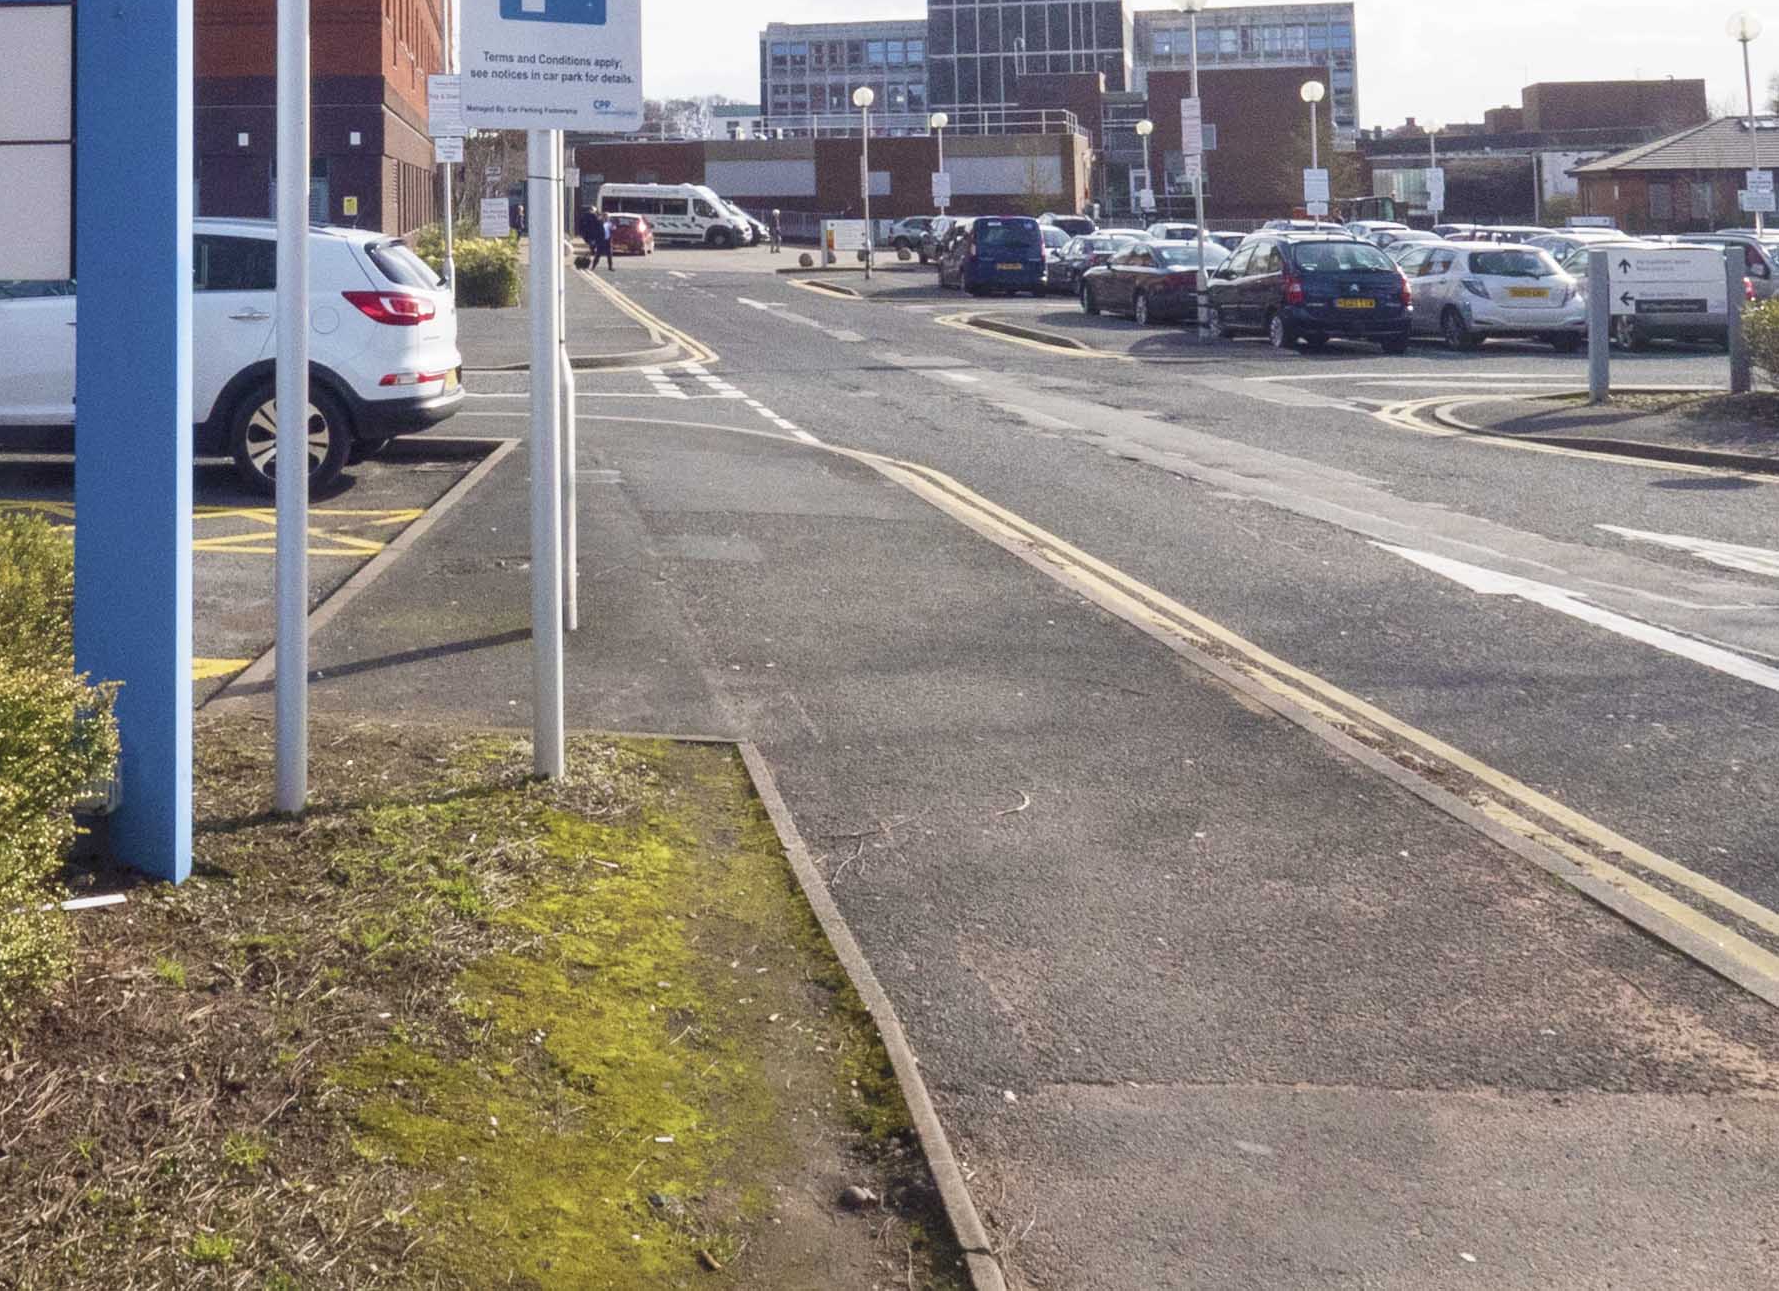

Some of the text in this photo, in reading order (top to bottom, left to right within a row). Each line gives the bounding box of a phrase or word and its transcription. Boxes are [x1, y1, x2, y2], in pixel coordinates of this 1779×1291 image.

[483, 50, 514, 63] Terms
[517, 54, 536, 64] and
[539, 54, 591, 66] Conditions
[470, 70, 488, 79] see
[491, 70, 528, 80] notices
[531, 70, 540, 80] in
[561, 73, 582, 83] park
[585, 72, 598, 82] for
